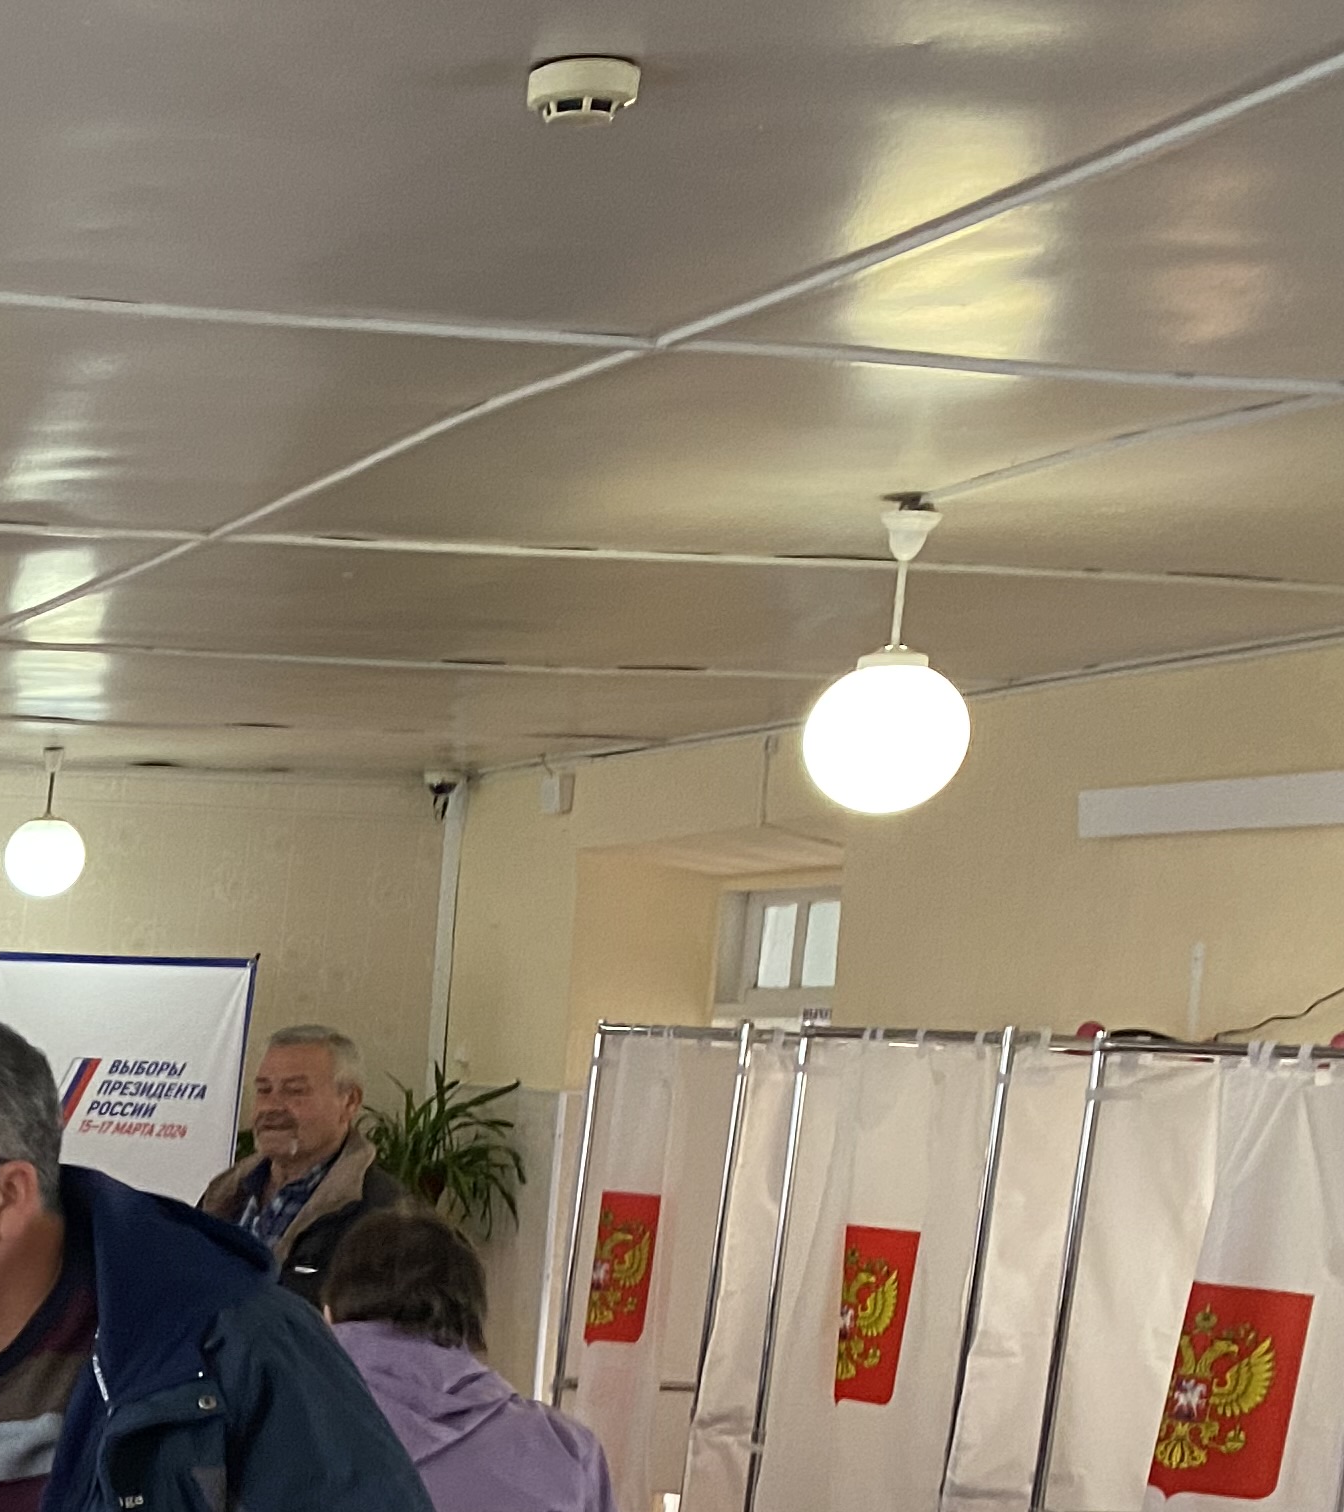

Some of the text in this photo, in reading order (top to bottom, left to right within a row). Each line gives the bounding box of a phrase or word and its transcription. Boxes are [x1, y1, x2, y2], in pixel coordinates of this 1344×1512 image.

[108, 1059, 187, 1077] ВЫБОРЫ
[96, 1079, 208, 1101] ПРЕЗИДЕНТА
[86, 1100, 157, 1118] РОССИИ
[114, 1122, 154, 1136] МАРТА
